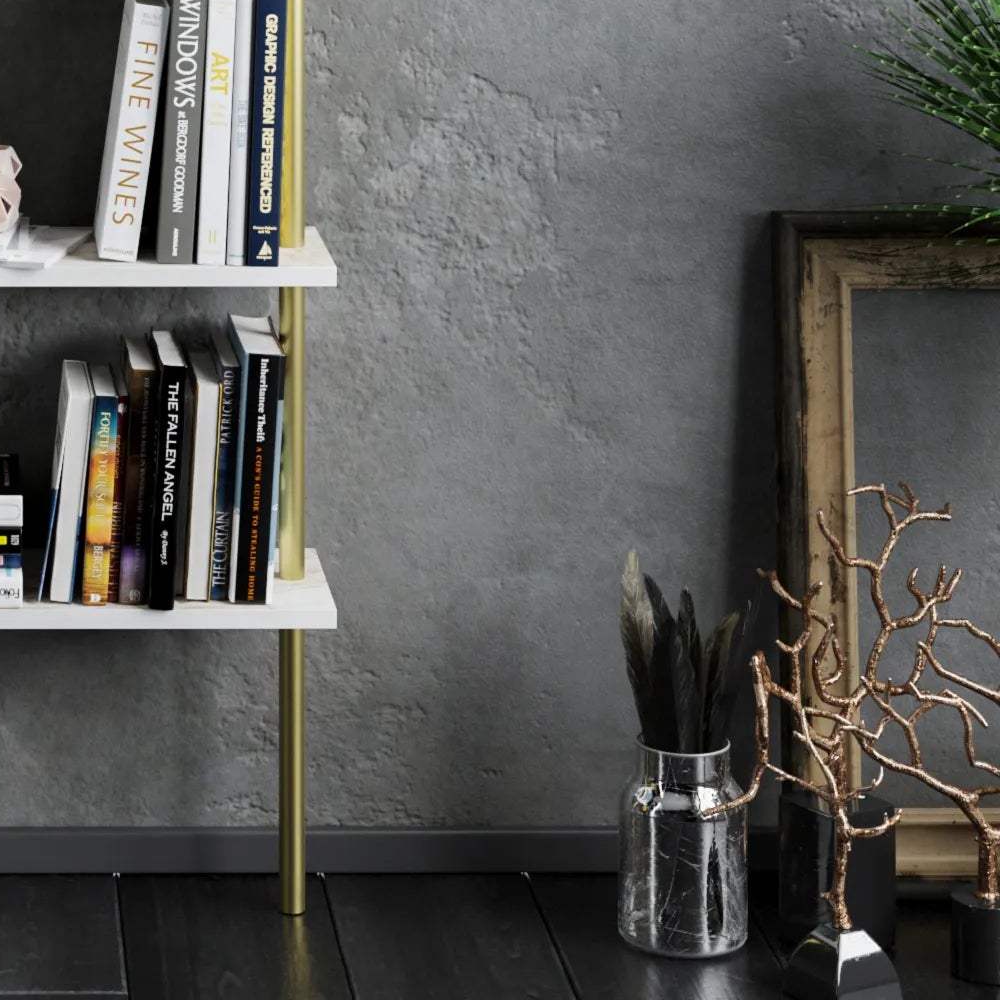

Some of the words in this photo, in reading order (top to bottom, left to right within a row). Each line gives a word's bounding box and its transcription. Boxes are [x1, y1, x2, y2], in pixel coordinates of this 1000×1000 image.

[264, 13, 279, 73] GRAPHIC
[128, 39, 158, 110] FINE
[209, 51, 230, 95] ART
[179, 110, 187, 118] at
[261, 75, 277, 125] DESIGN
[175, 117, 189, 166] BERGDORF
[112, 124, 147, 227] WINES
[172, 166, 186, 213] GOODMAN
[259, 127, 275, 214] REFERENCED
[167, 381, 180, 412] THE
[223, 370, 235, 395] ORD
[257, 358, 269, 413] Inheritance
[97, 411, 112, 456] FORTIFY
[164, 413, 179, 469] FALLEN
[220, 397, 233, 444] PATRICK
[94, 459, 108, 489] YOUR
[254, 454, 262, 481] CON'S
[161, 470, 175, 522] ANGEL
[252, 484, 260, 512] GUIDE
[213, 511, 230, 563] CURTAIN
[251, 516, 258, 527] TO
[91, 545, 104, 581] BERGEY
[249, 529, 258, 572] STEALING
[211, 563, 227, 587] THE
[247, 575, 256, 601] HOME
